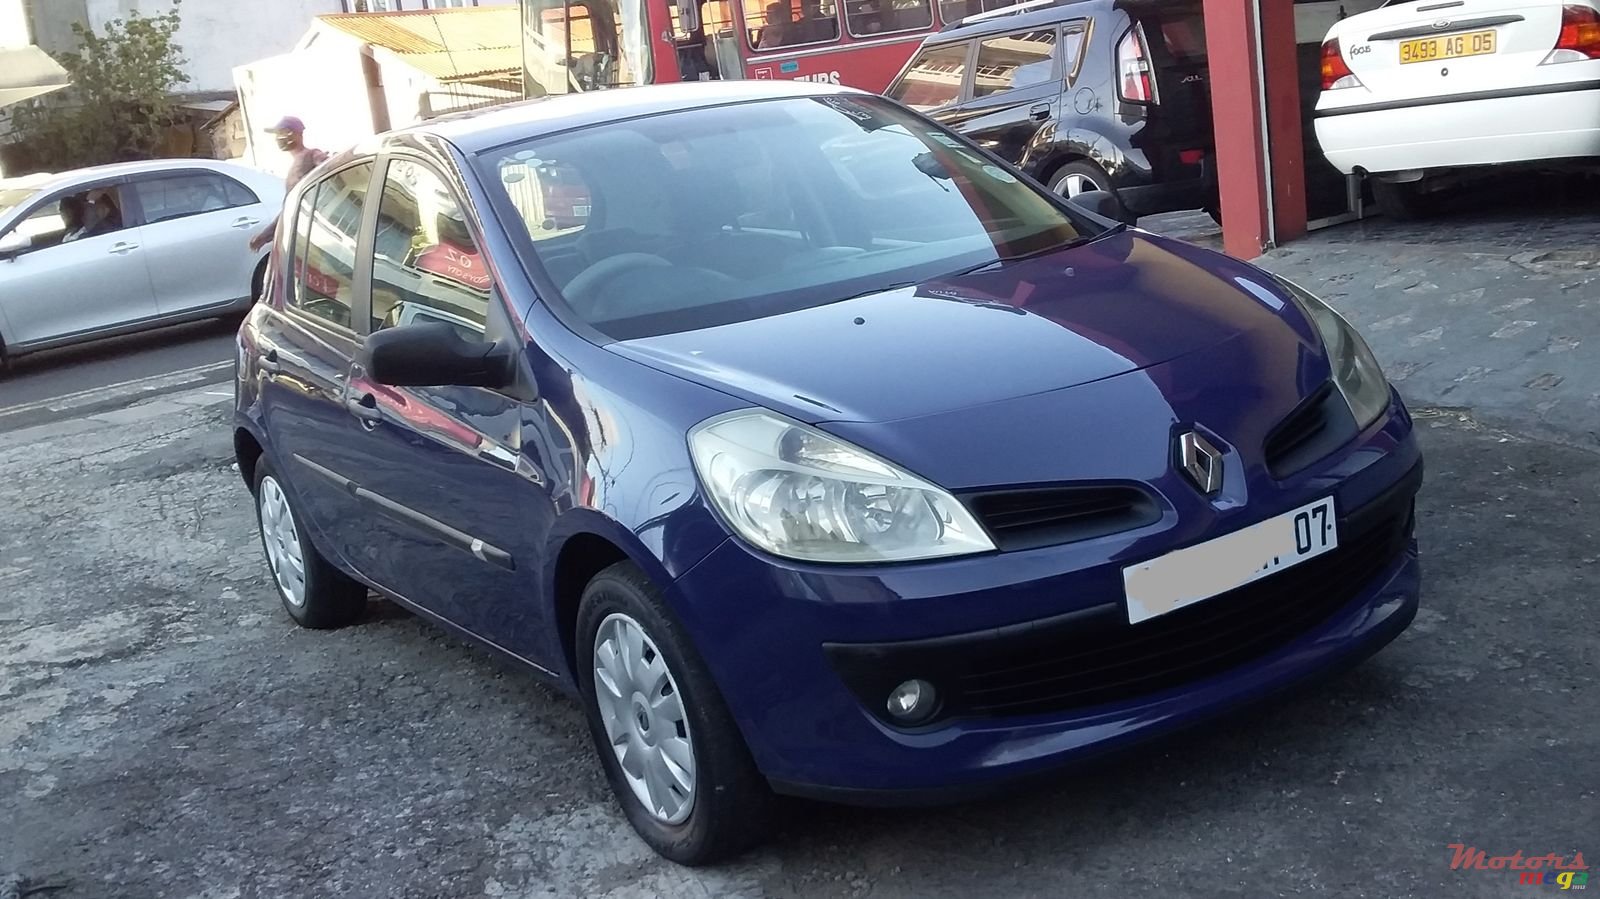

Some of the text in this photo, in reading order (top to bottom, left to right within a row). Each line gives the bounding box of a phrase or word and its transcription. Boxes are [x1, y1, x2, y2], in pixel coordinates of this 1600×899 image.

[1403, 33, 1492, 60] 3493 AG 05
[1294, 504, 1328, 554] 07
